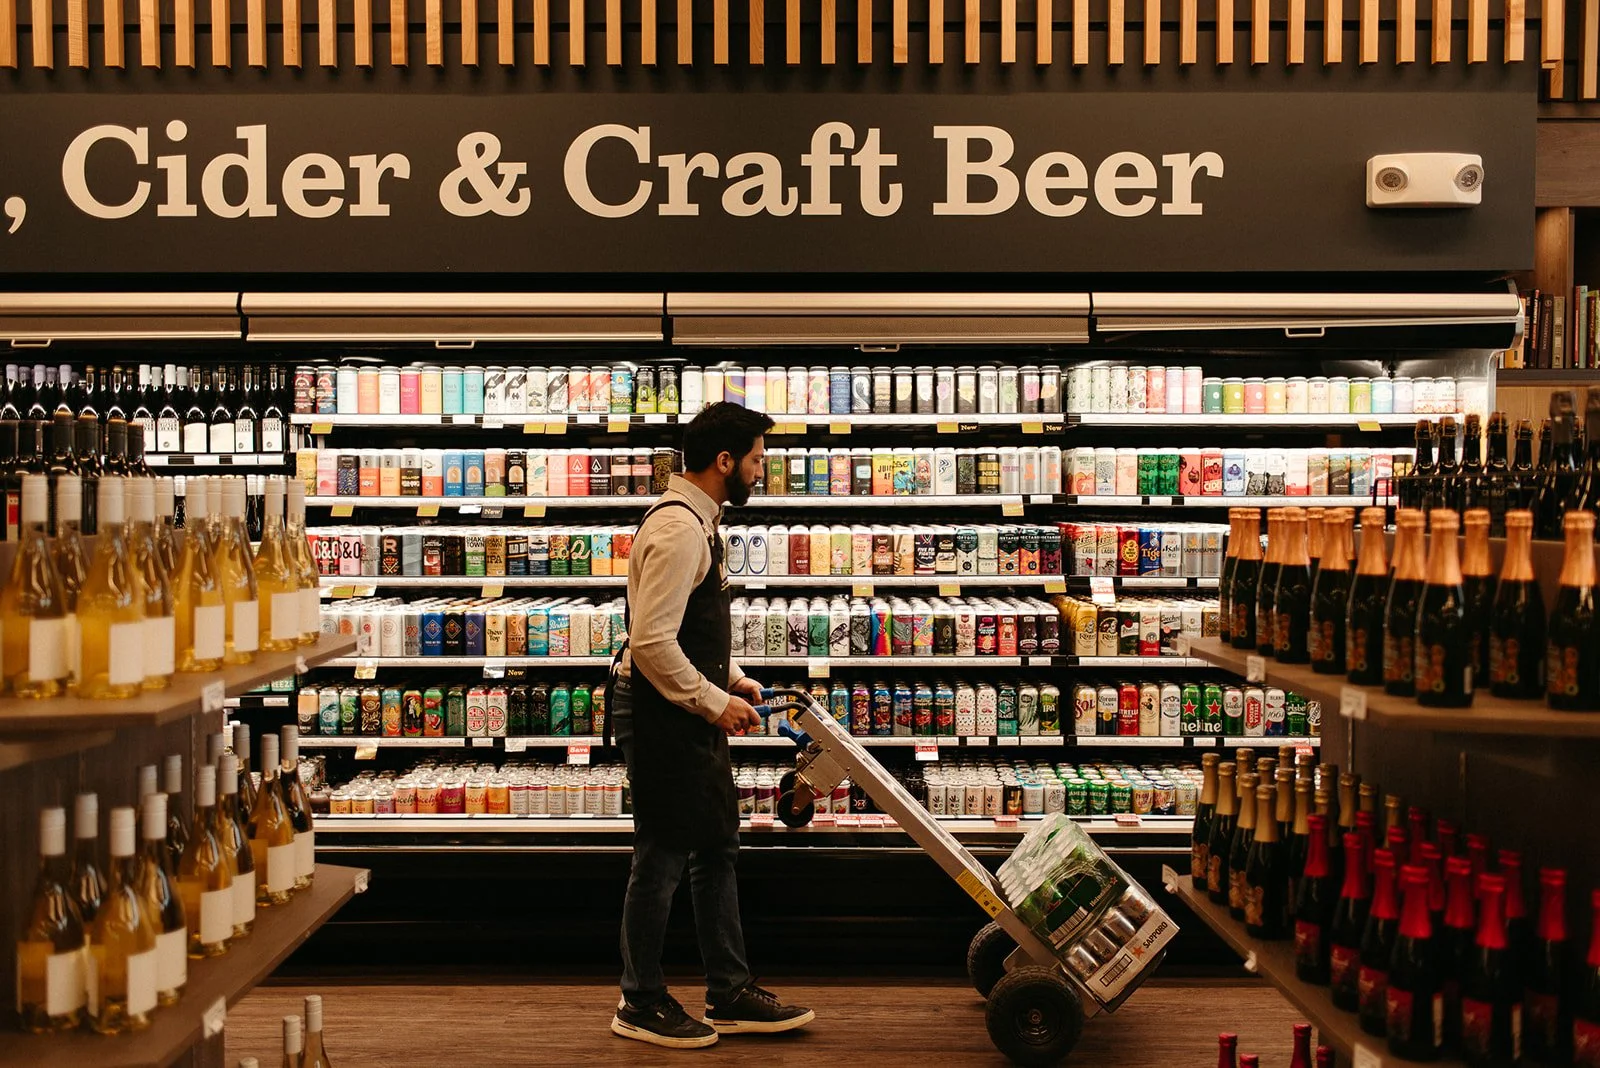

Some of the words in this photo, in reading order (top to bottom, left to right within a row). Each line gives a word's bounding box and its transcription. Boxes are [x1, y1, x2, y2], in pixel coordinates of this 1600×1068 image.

[62, 119, 411, 220] Cider
[439, 131, 532, 218] &
[563, 122, 903, 219] Craft
[932, 125, 1224, 218] Beer
[487, 555, 502, 564] IPA
[1042, 703, 1056, 712] IPA
[1142, 921, 1168, 949] SAPPORO
